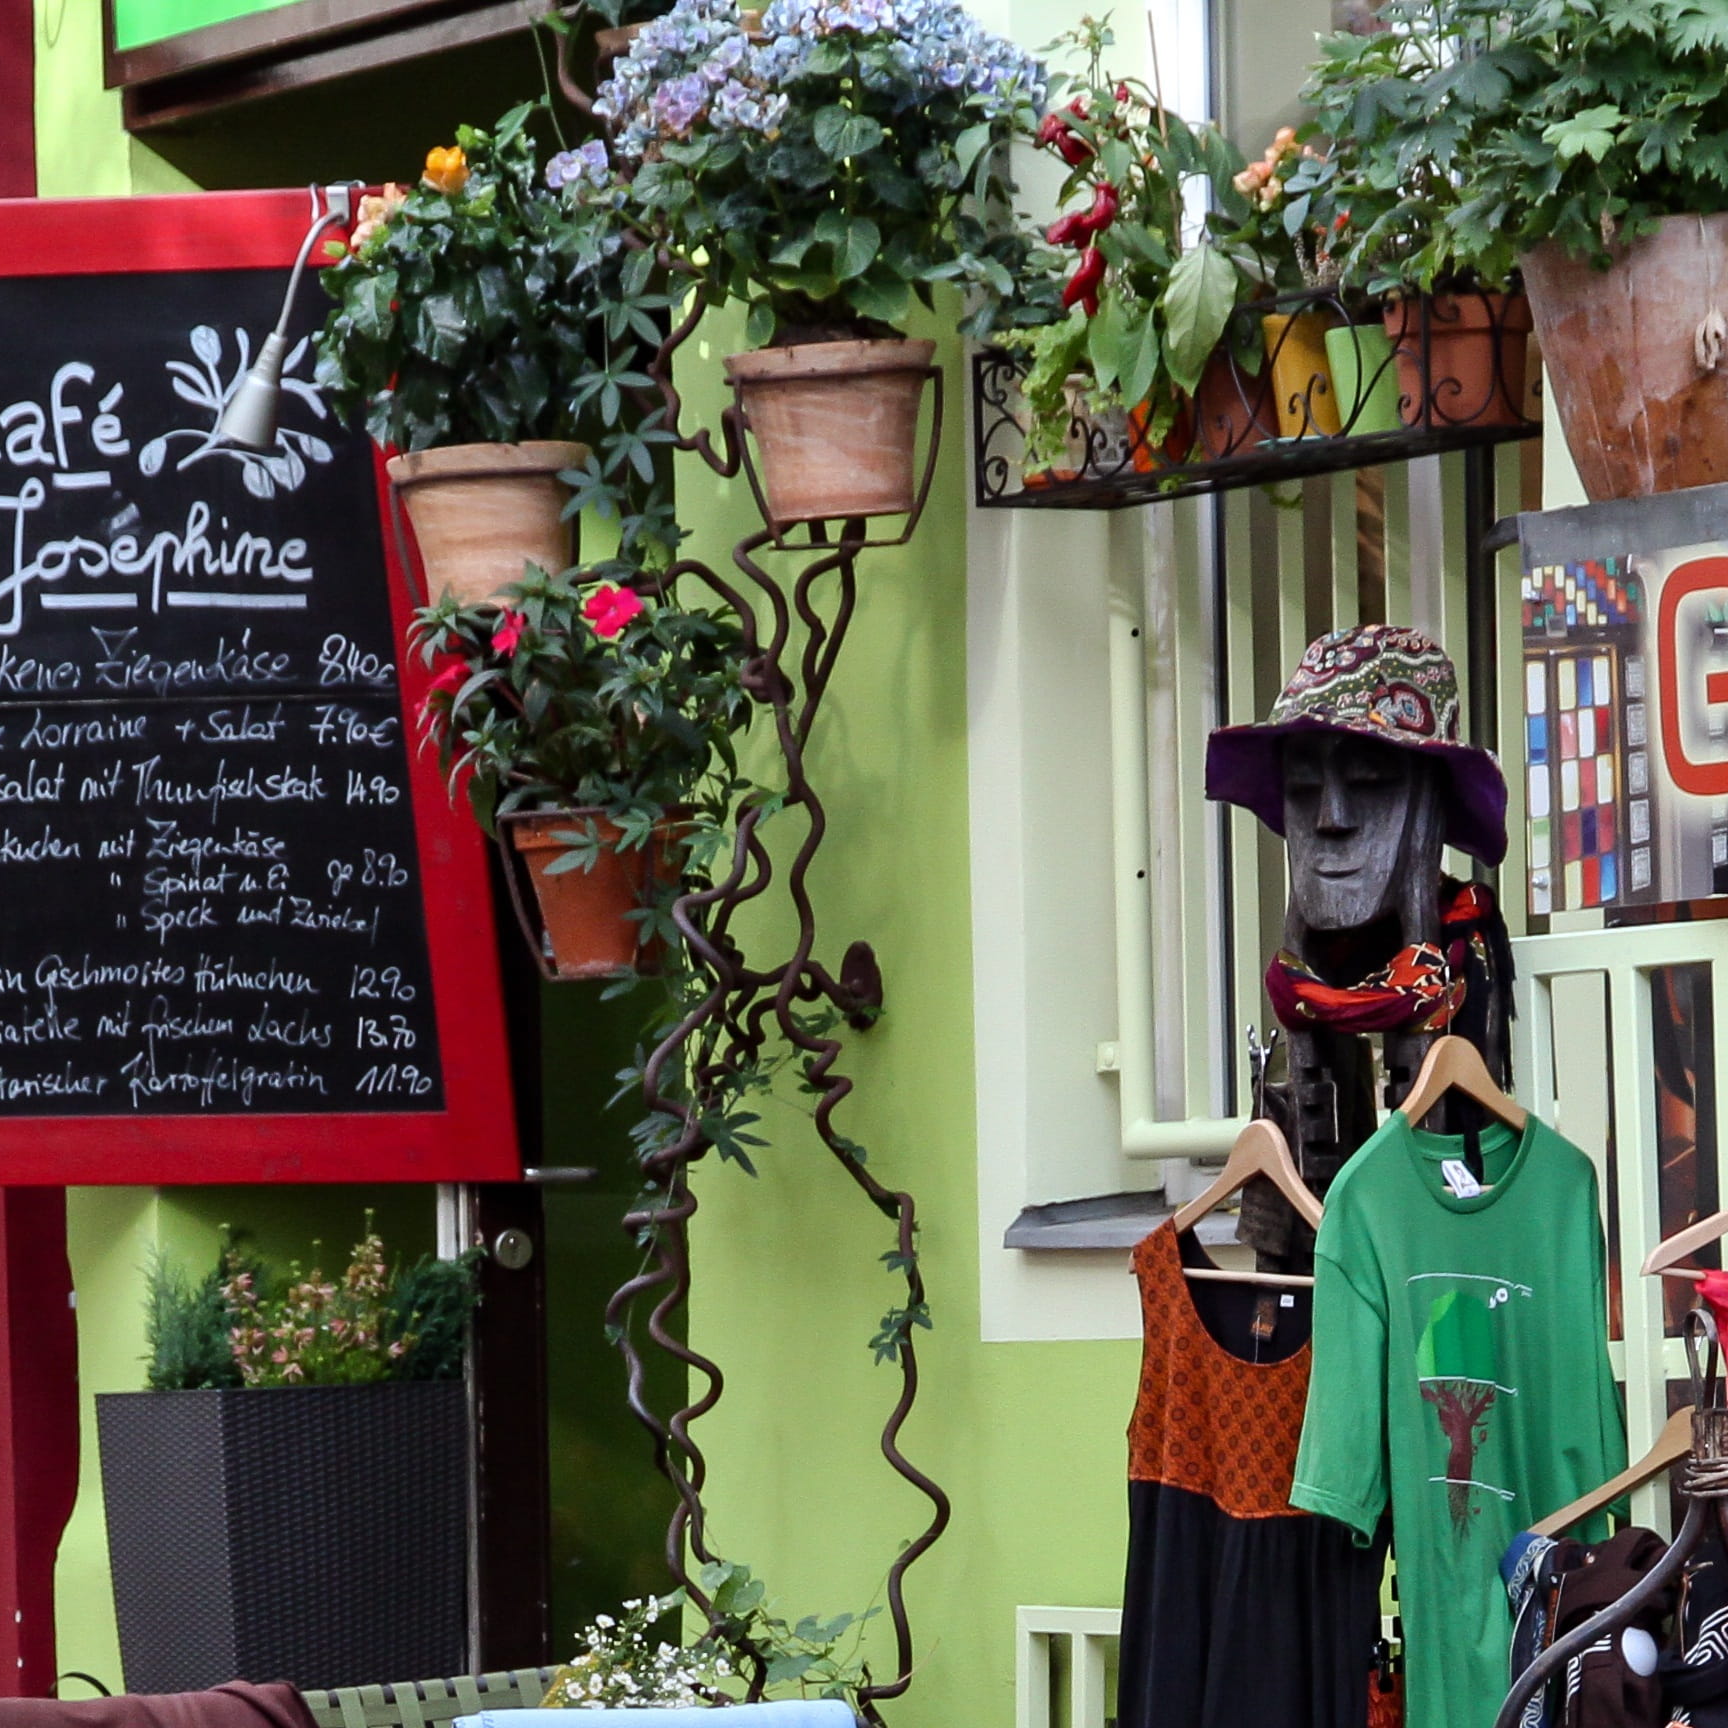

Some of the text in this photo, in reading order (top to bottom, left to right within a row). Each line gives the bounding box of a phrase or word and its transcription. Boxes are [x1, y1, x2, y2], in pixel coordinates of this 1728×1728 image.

[21, 708, 147, 750] Lorraine
[200, 702, 286, 742] Salat
[310, 703, 398, 748] 7.90€
[79, 759, 122, 801] mit
[98, 828, 134, 859] mit
[142, 863, 239, 907] Spinat
[140, 897, 219, 946] Speck
[236, 896, 284, 926] und
[349, 963, 416, 1001] 12.90
[96, 1000, 132, 1037] mit
[247, 1001, 333, 1048] Lachs
[356, 1014, 416, 1050] 13.70
[355, 1063, 433, 1095] 11.90
